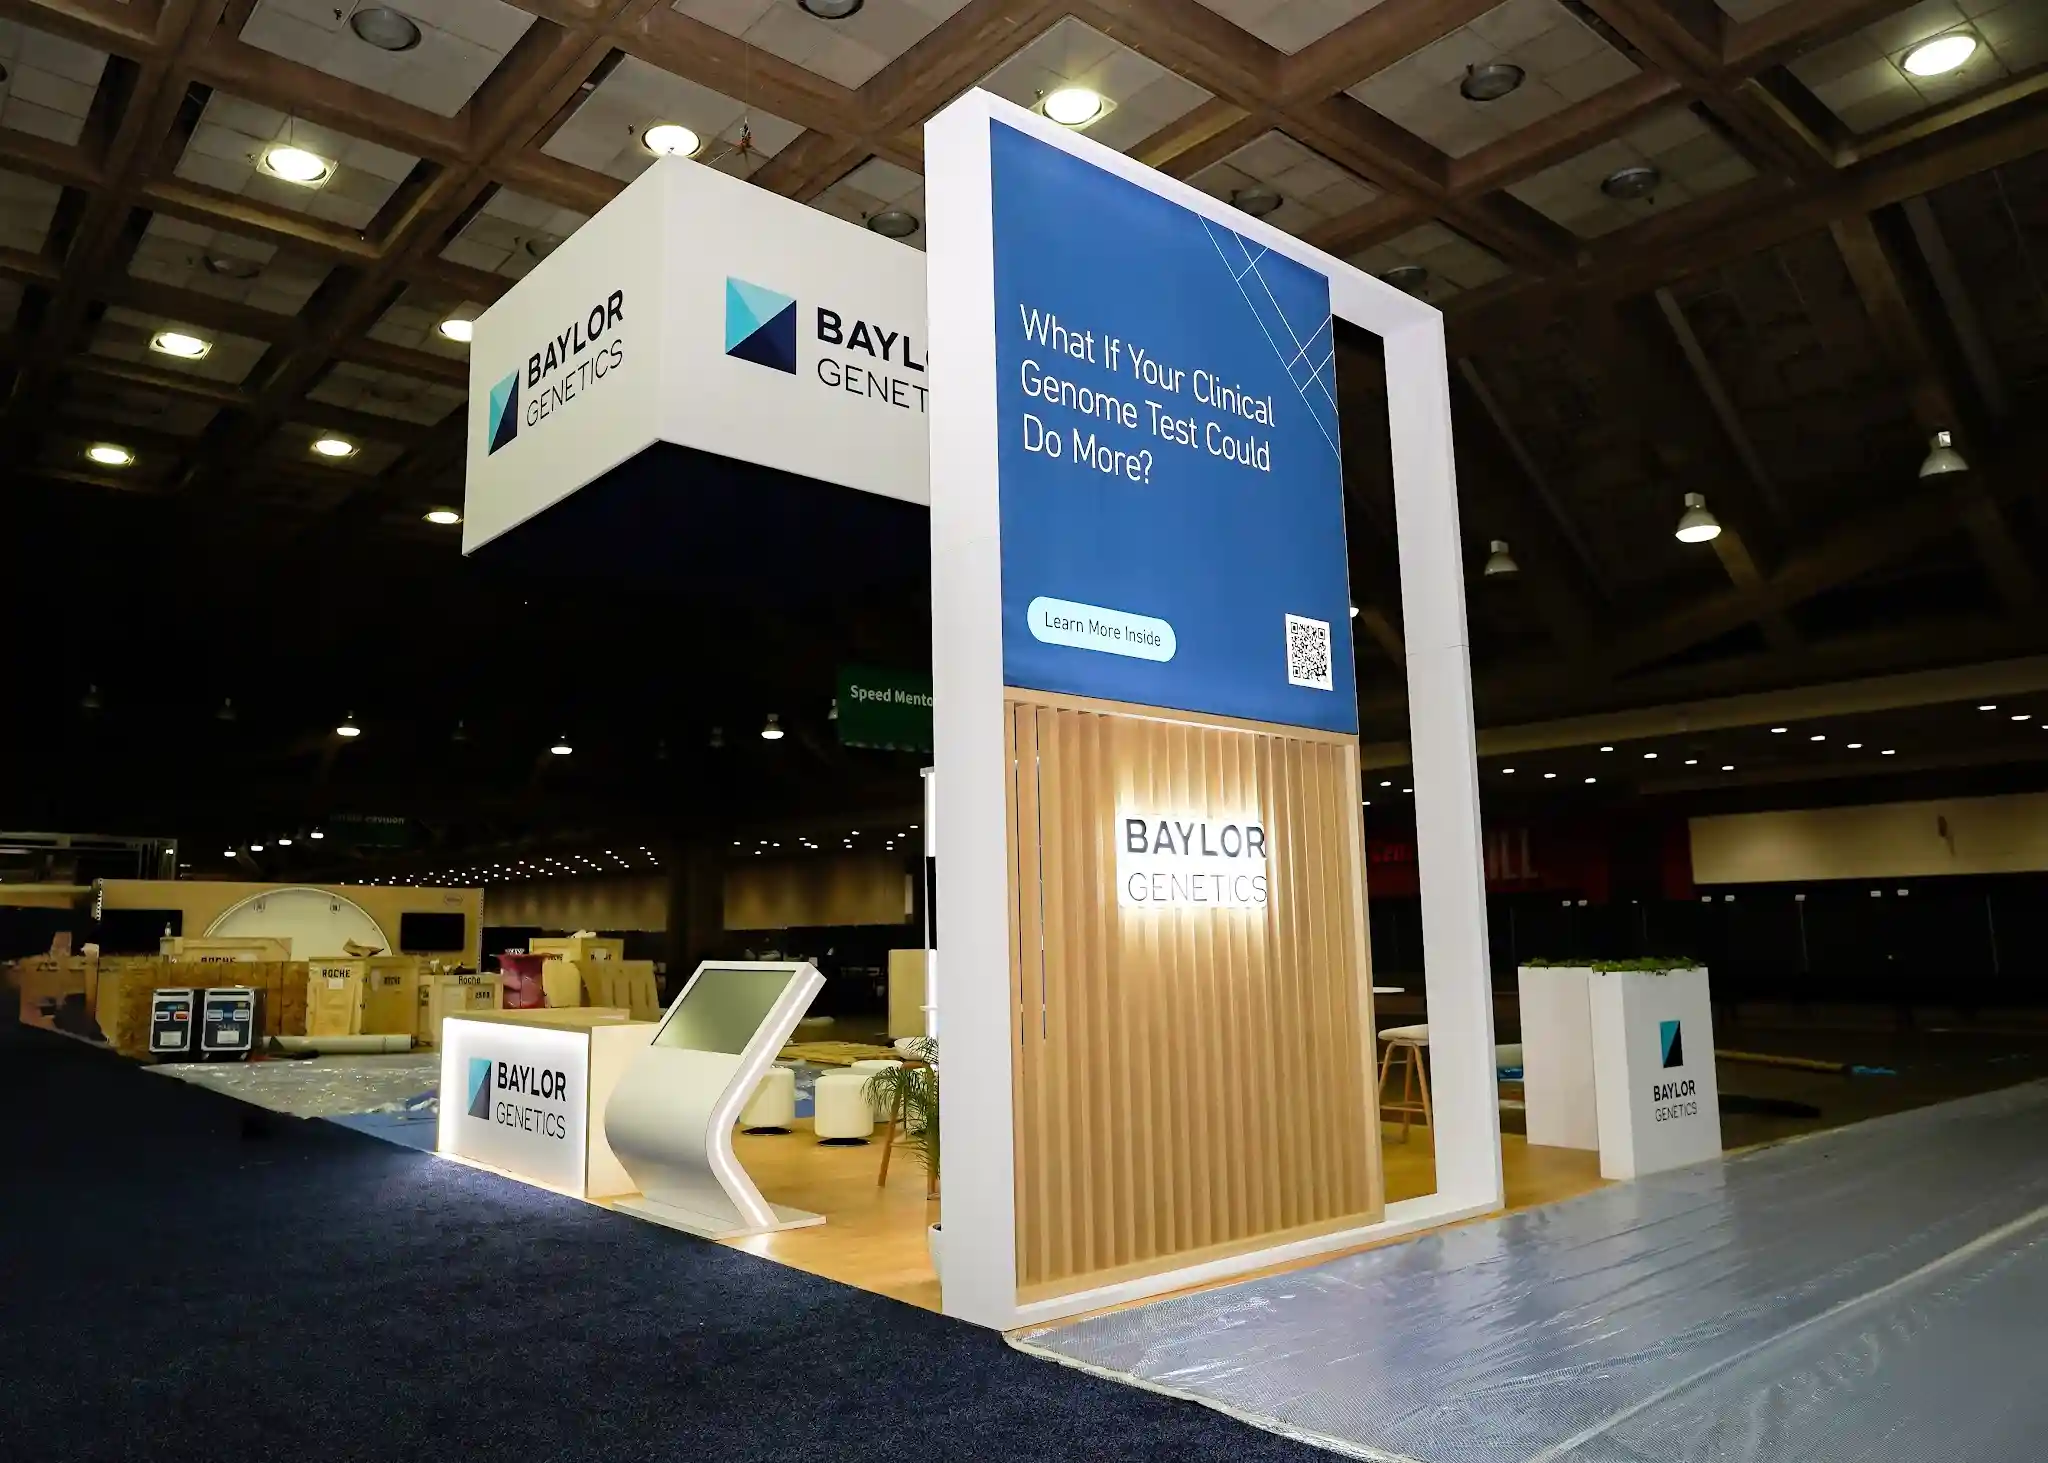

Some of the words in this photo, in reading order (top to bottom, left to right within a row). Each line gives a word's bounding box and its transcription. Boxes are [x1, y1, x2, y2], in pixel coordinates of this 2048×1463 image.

[528, 290, 623, 389] BAYLOR
[817, 306, 929, 372] BAYL
[527, 339, 623, 426] GENETICS
[1020, 304, 1095, 363] What
[1104, 335, 1119, 371] If
[1128, 343, 1185, 393] Your
[1193, 369, 1275, 427] Clinical
[1021, 359, 1138, 429] Genome
[1145, 400, 1198, 448] Test
[1206, 422, 1271, 472] Could
[1023, 413, 1062, 457] Do
[1072, 428, 1153, 484] More?
[1045, 611, 1084, 633] Learn
[1088, 618, 1121, 640] More
[1125, 626, 1161, 647] Inside
[850, 684, 892, 703] Speed
[1126, 818, 1267, 858] BAYLOR
[1127, 872, 1267, 903] GENETICS
[322, 969, 351, 978] ROCHE
[497, 1061, 566, 1102] BAYLOR
[1653, 1079, 1696, 1102] BAYLOR
[496, 1101, 566, 1140] GENETICS
[1655, 1101, 1697, 1122] GENETICS
